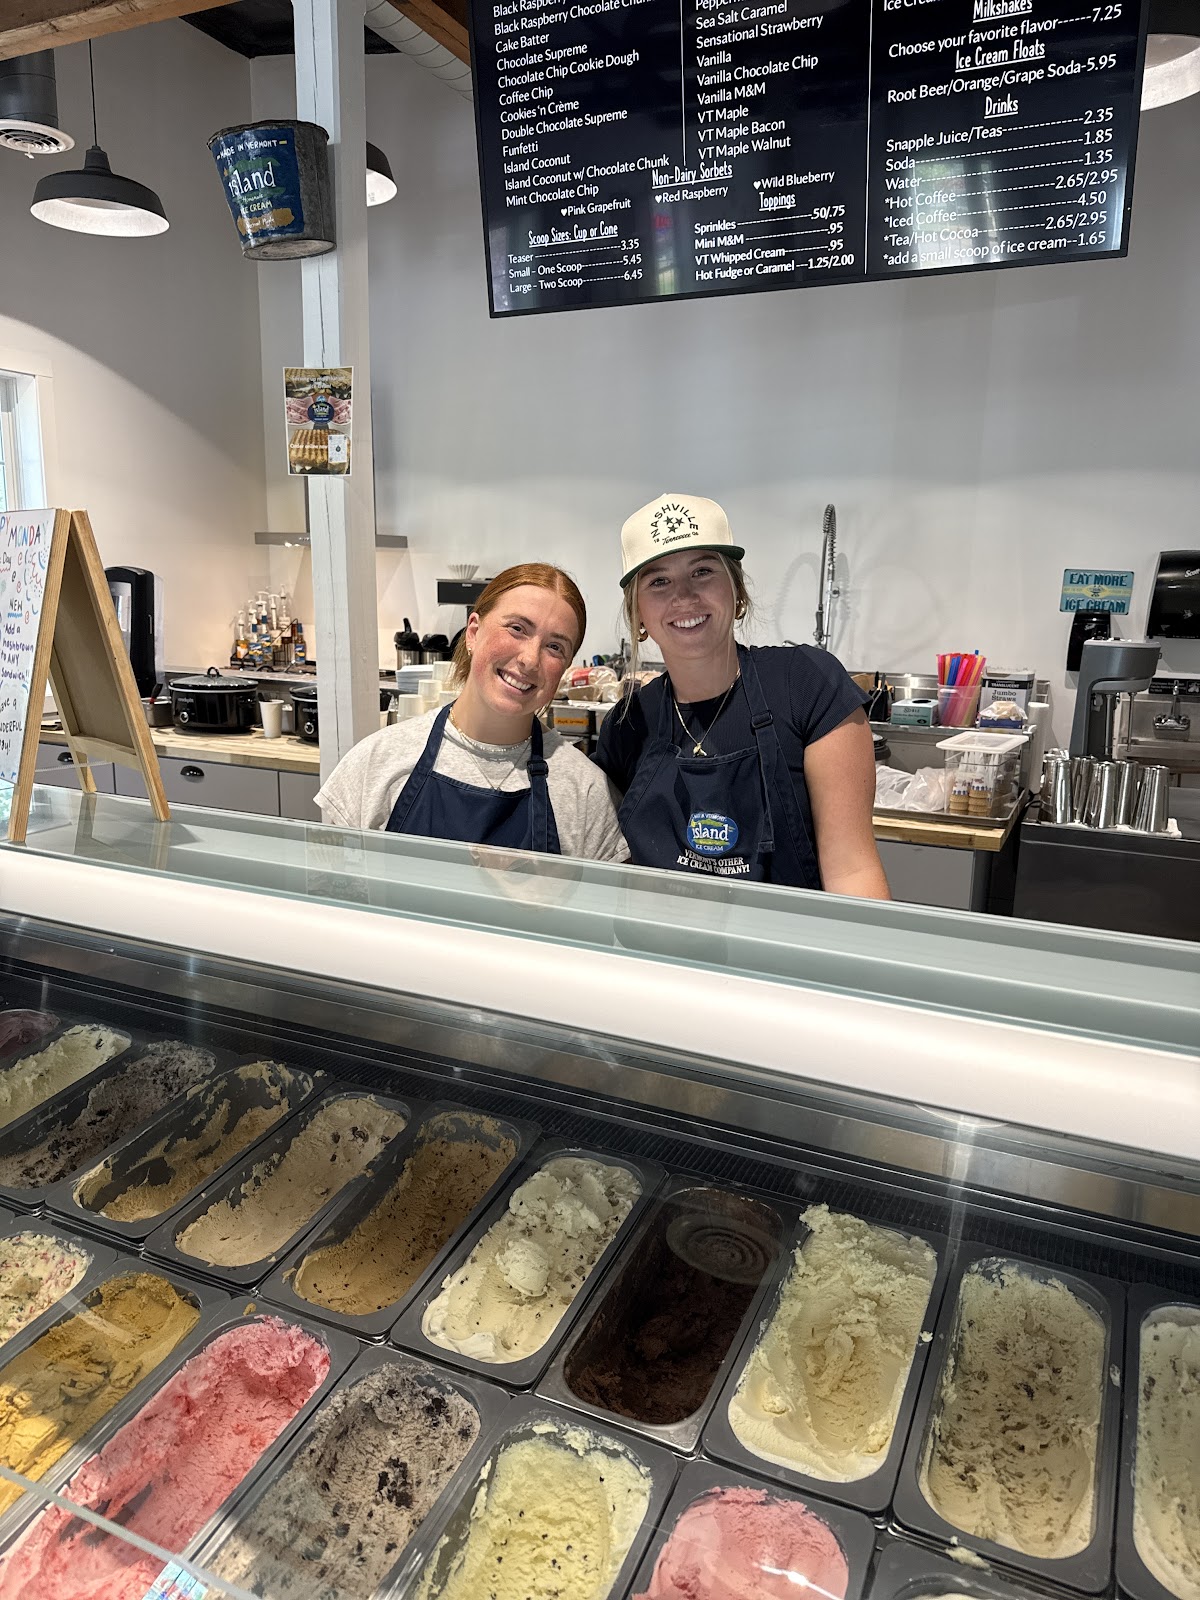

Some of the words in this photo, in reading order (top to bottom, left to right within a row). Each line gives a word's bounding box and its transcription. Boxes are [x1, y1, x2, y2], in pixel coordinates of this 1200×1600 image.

[493, 3, 518, 17] Black
[494, 20, 519, 35] Black
[521, 10, 568, 29] Raspberry
[570, 0, 620, 18] Chocolate
[696, 17, 715, 30] Sea
[717, 10, 738, 25] Salt
[740, 1, 788, 21] Caramel
[973, 0, 1032, 20] Milkshakes
[496, 38, 519, 53] Cake
[520, 33, 549, 48] Batter
[696, 25, 758, 49] Sensational
[760, 16, 823, 37] Strawberry
[889, 40, 936, 57] Choose
[938, 35, 967, 52] your
[968, 25, 1018, 44] favorite
[1020, 18, 1059, 35] flavor
[1092, 4, 1122, 22] 7.25
[497, 53, 543, 70] Chocolate
[545, 44, 588, 61] Supreme
[696, 50, 732, 68] Vanilla
[955, 50, 971, 69] Ice
[975, 46, 1008, 66] Cream
[1013, 39, 1045, 60] Floats
[498, 70, 544, 88] Chocolate
[546, 64, 568, 79] Chip
[570, 58, 604, 74] Cookie
[606, 49, 640, 67] Dough
[697, 69, 732, 86] Vanilla
[734, 61, 789, 80] Chocolate
[792, 55, 818, 69] Chip
[697, 88, 732, 105] Vanilla
[734, 82, 766, 99] M&M
[888, 88, 917, 103] Root
[920, 68, 1044, 98] Beer/Orange/Grape
[1047, 60, 1081, 78] Soda
[499, 90, 530, 105] Coffee
[531, 86, 553, 100] Chip
[985, 93, 1019, 117] Drinks
[500, 107, 536, 123] Cookies
[548, 101, 579, 114] Crème
[698, 110, 714, 124] VT
[716, 106, 749, 122] Maple
[502, 124, 534, 140] Double
[536, 117, 583, 134] Chocolate
[585, 110, 628, 127] Supreme
[698, 129, 714, 142] VT
[716, 124, 749, 140] Maple
[751, 120, 786, 134] Bacon
[886, 134, 935, 152] Snapple
[936, 126, 1003, 145] Juice/Teas
[1083, 107, 1114, 125] 2.35
[220, 146, 235, 159] MADE
[237, 143, 244, 152] IN
[245, 140, 277, 150] VERMONT
[503, 141, 538, 157] Funfetti
[698, 147, 714, 160] VT
[716, 142, 749, 158] Maple
[751, 136, 791, 152] Walnut
[885, 156, 915, 171] Soda
[1083, 128, 1113, 145] 1.85
[504, 159, 529, 174] Island
[531, 154, 571, 169] Coconut
[505, 176, 531, 190] Island
[532, 170, 572, 186] Coconut
[573, 167, 585, 180] w/
[586, 161, 635, 178] Chocolate
[637, 154, 670, 170] Chunk
[652, 166, 696, 187] Non-Dairy
[700, 161, 733, 179] Sorbets
[885, 177, 922, 190] Water
[1083, 149, 1113, 165] 1.35
[761, 176, 784, 189] Wild
[786, 171, 835, 186] Blueberry
[915, 190, 956, 206] Coffee
[1055, 169, 1118, 189] 2.65/2.95
[250, 200, 273, 212] CREAM
[506, 193, 528, 207] Mint
[529, 186, 575, 203] Chocolate
[577, 184, 599, 197] Chip
[662, 190, 680, 202] Red
[682, 186, 728, 201] Raspberry
[759, 191, 796, 210] Toppings
[567, 202, 586, 216] Pink
[587, 198, 631, 214] Grapefruit
[916, 209, 957, 225] Coffee
[1077, 190, 1107, 206] 4.50
[694, 220, 736, 235] Sprinkles
[811, 205, 845, 220] .50/.75
[939, 228, 978, 241] Cocoa
[1045, 211, 1108, 230] 2.65/2.95
[528, 230, 549, 247] Scoop
[551, 227, 572, 243] Sizes:
[573, 224, 587, 242] Cup
[590, 228, 598, 237] or
[600, 221, 618, 236] Cone
[695, 238, 715, 249] Mini
[717, 234, 744, 247] M&M
[827, 222, 844, 234] .95
[508, 253, 533, 264] Teaser
[620, 239, 640, 250] 3.35
[695, 255, 709, 265] VT
[710, 249, 752, 264] Whipped
[754, 248, 785, 259] Cream
[827, 239, 844, 251] .95
[911, 255, 918, 263] a
[920, 247, 952, 262] small
[954, 245, 989, 258] scoop
[992, 240, 1007, 255] of
[1007, 241, 1024, 253] ice
[1027, 237, 1067, 250] cream
[1077, 231, 1106, 246] 1.65
[508, 267, 530, 279] Small
[537, 265, 555, 276] One
[556, 262, 582, 274] Scoop
[623, 253, 642, 265] 5.45
[695, 270, 713, 281] Hot
[715, 266, 743, 279] Fudge
[744, 266, 754, 275] or
[755, 260, 795, 274] Caramel
[807, 254, 854, 269] 1.25/2.00
[509, 283, 532, 294] Large
[539, 280, 556, 290] Two
[557, 277, 583, 288] Scoop
[624, 269, 643, 281] 6.45
[650, 503, 699, 539] NASHVILLE
[8, 521, 49, 548] MONDAY
[1069, 572, 1092, 585] EAT
[1093, 573, 1128, 587] MORE
[9, 599, 23, 612] NEW
[1064, 598, 1085, 610] ICE
[1085, 599, 1126, 613] CREAM
[3, 638, 34, 652] hashbrown
[8, 653, 19, 666] ANY
[676, 855, 690, 866] ICE
[690, 859, 713, 872] CREAM
[713, 863, 750, 875] COMPANY!
[718, 857, 744, 867] OTHER
